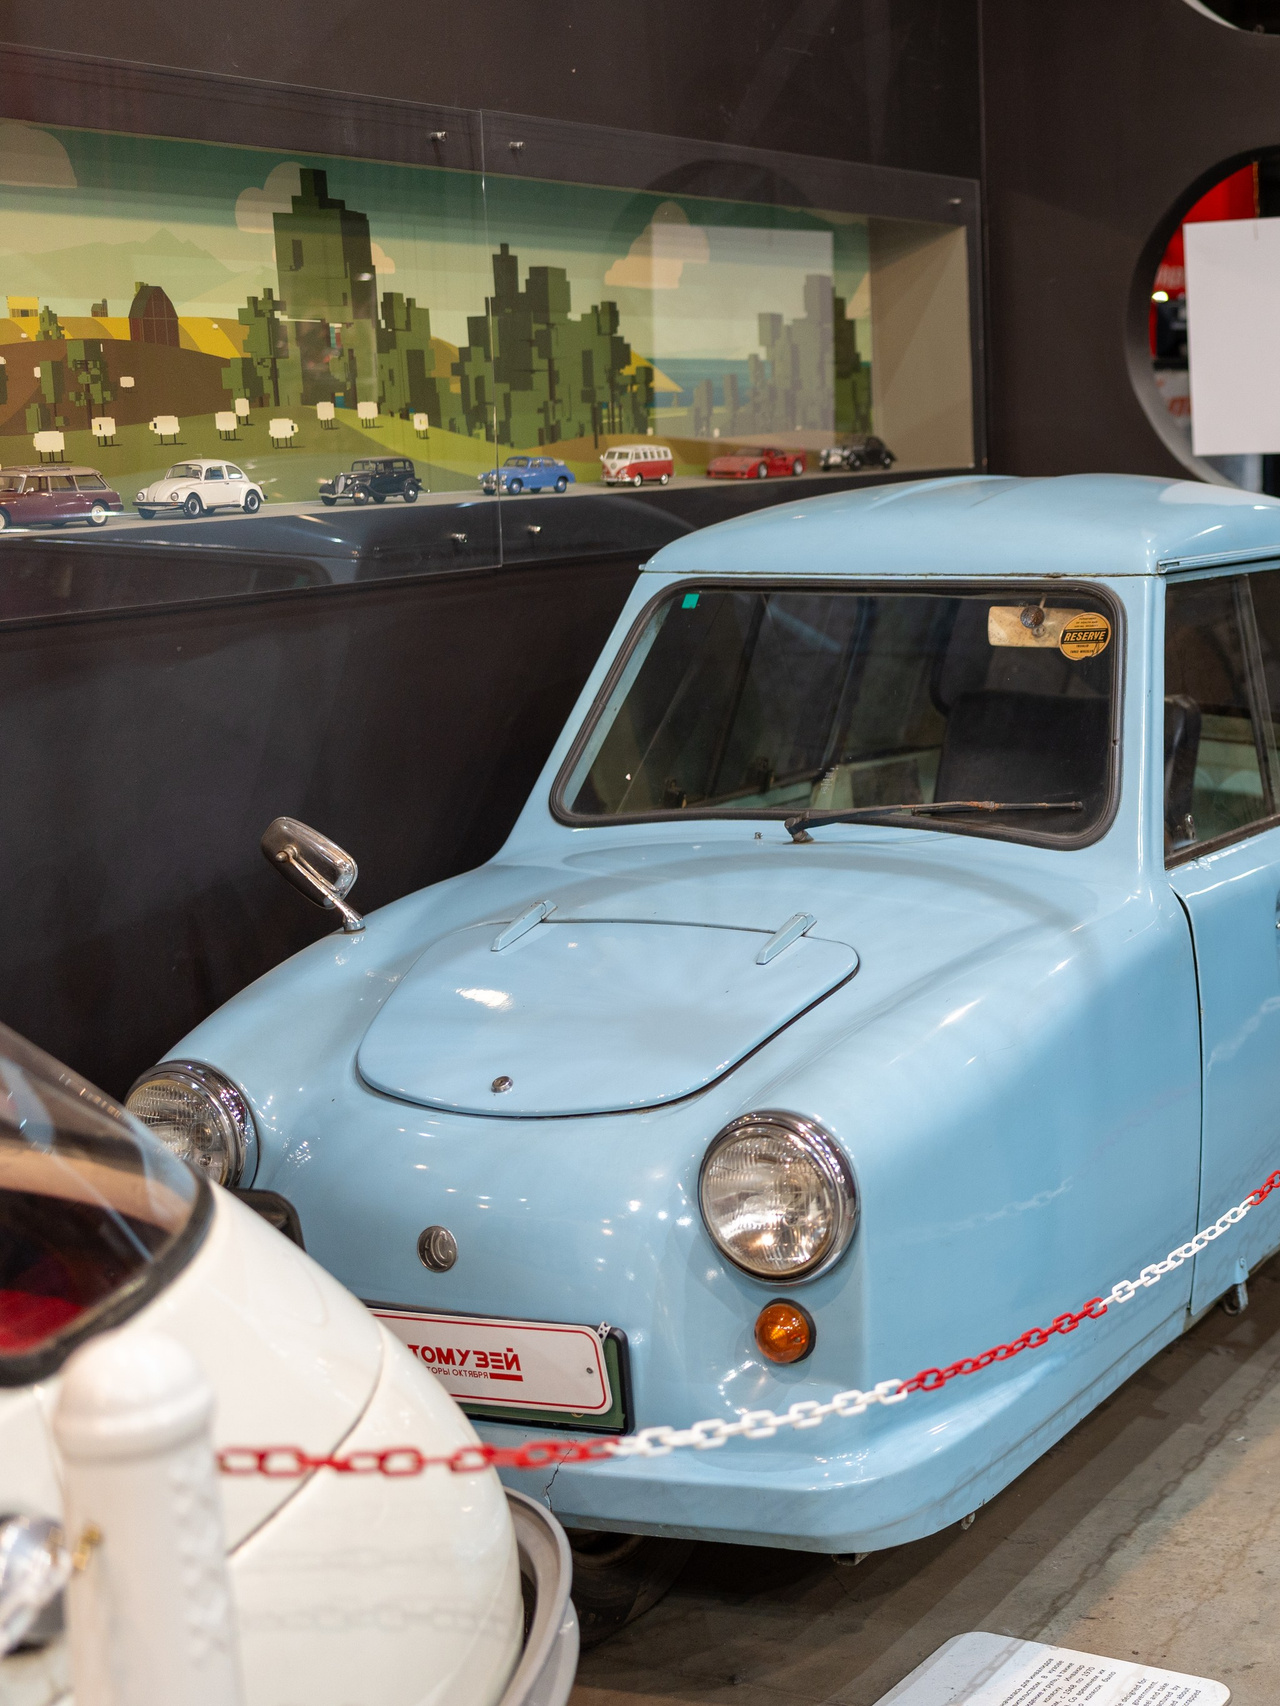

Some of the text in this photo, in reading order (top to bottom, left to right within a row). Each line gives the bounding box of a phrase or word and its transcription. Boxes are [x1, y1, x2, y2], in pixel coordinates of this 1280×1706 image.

[1064, 632, 1106, 641] RESERVE
[407, 1344, 521, 1372] ТОМУЗЕЙ
[426, 1366, 489, 1379] ТОРЫ ОКТЯБРЯ
[1021, 1680, 1030, 1688] для
[1030, 1659, 1053, 1679] инвалидов
[1048, 1661, 1064, 1673] кузове
[1059, 1663, 1074, 1674] также
[1063, 1685, 1077, 1694] 1948
[1081, 1667, 1095, 1677] 1970
[1076, 1676, 1099, 1696] временем
[1084, 1672, 1116, 1701] колясок было
[1121, 1685, 1141, 1702] designed
[1132, 1682, 1160, 1705] government.
[1150, 1692, 1160, 1700] and
[1157, 1683, 1169, 1691] take
[1177, 1688, 1190, 1699] about
